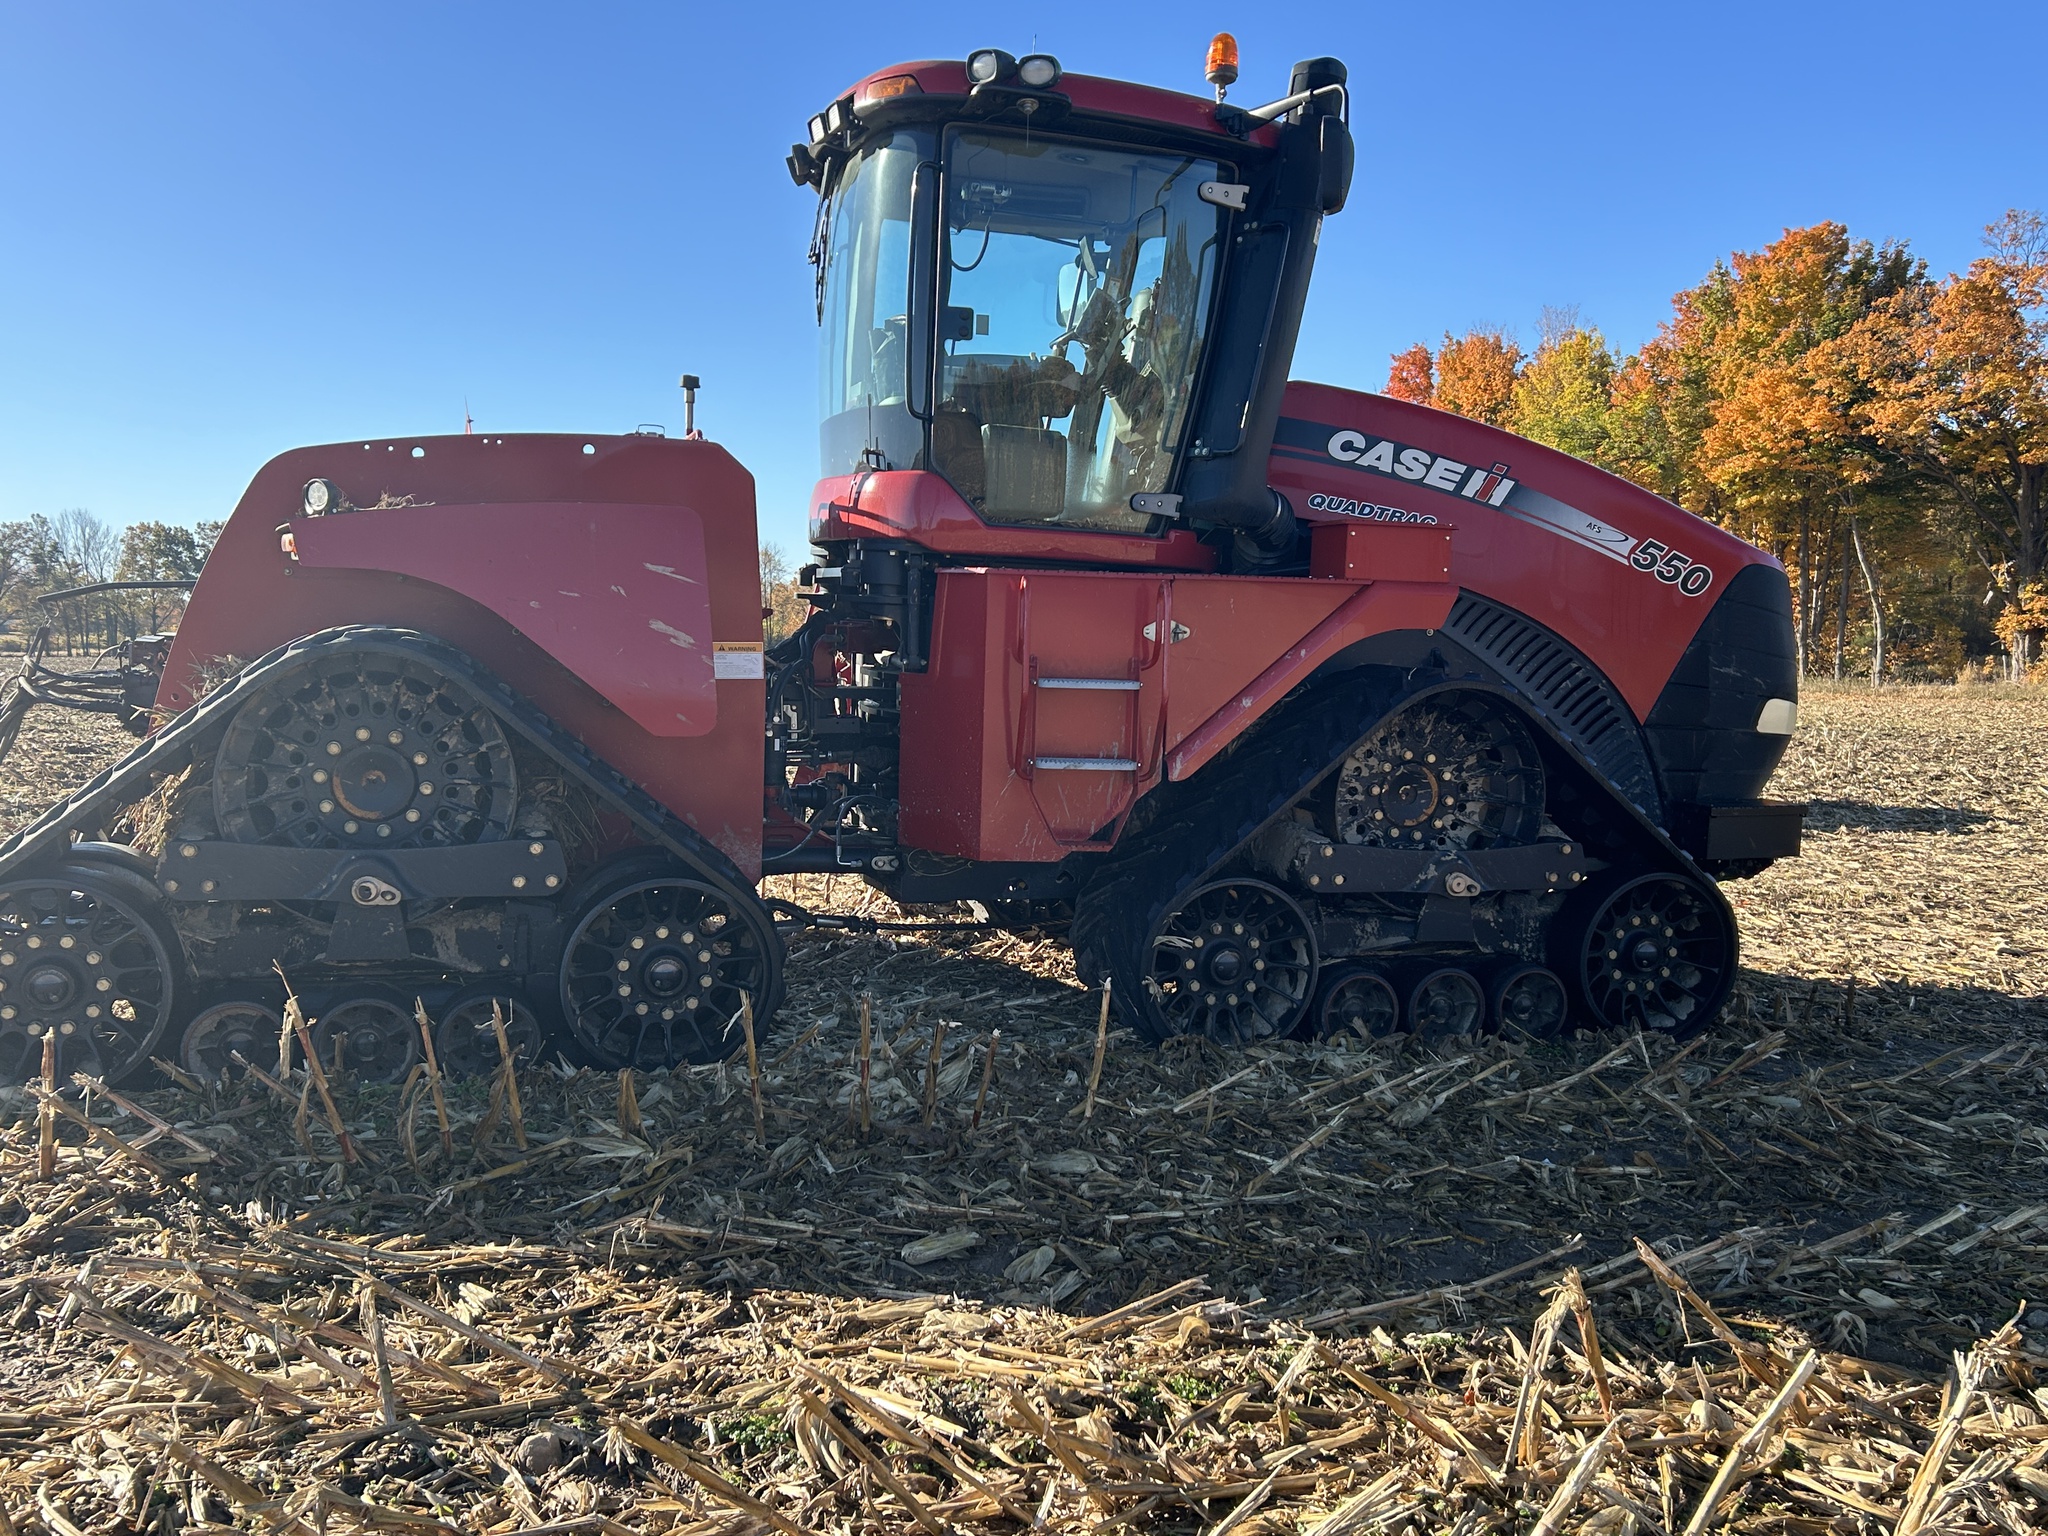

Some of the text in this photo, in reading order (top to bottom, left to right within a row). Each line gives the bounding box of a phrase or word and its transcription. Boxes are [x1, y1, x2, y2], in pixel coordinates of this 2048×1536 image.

[1327, 430, 1468, 492] CASE
[1586, 522, 1602, 534] AFS
[1630, 537, 1713, 597] 550
